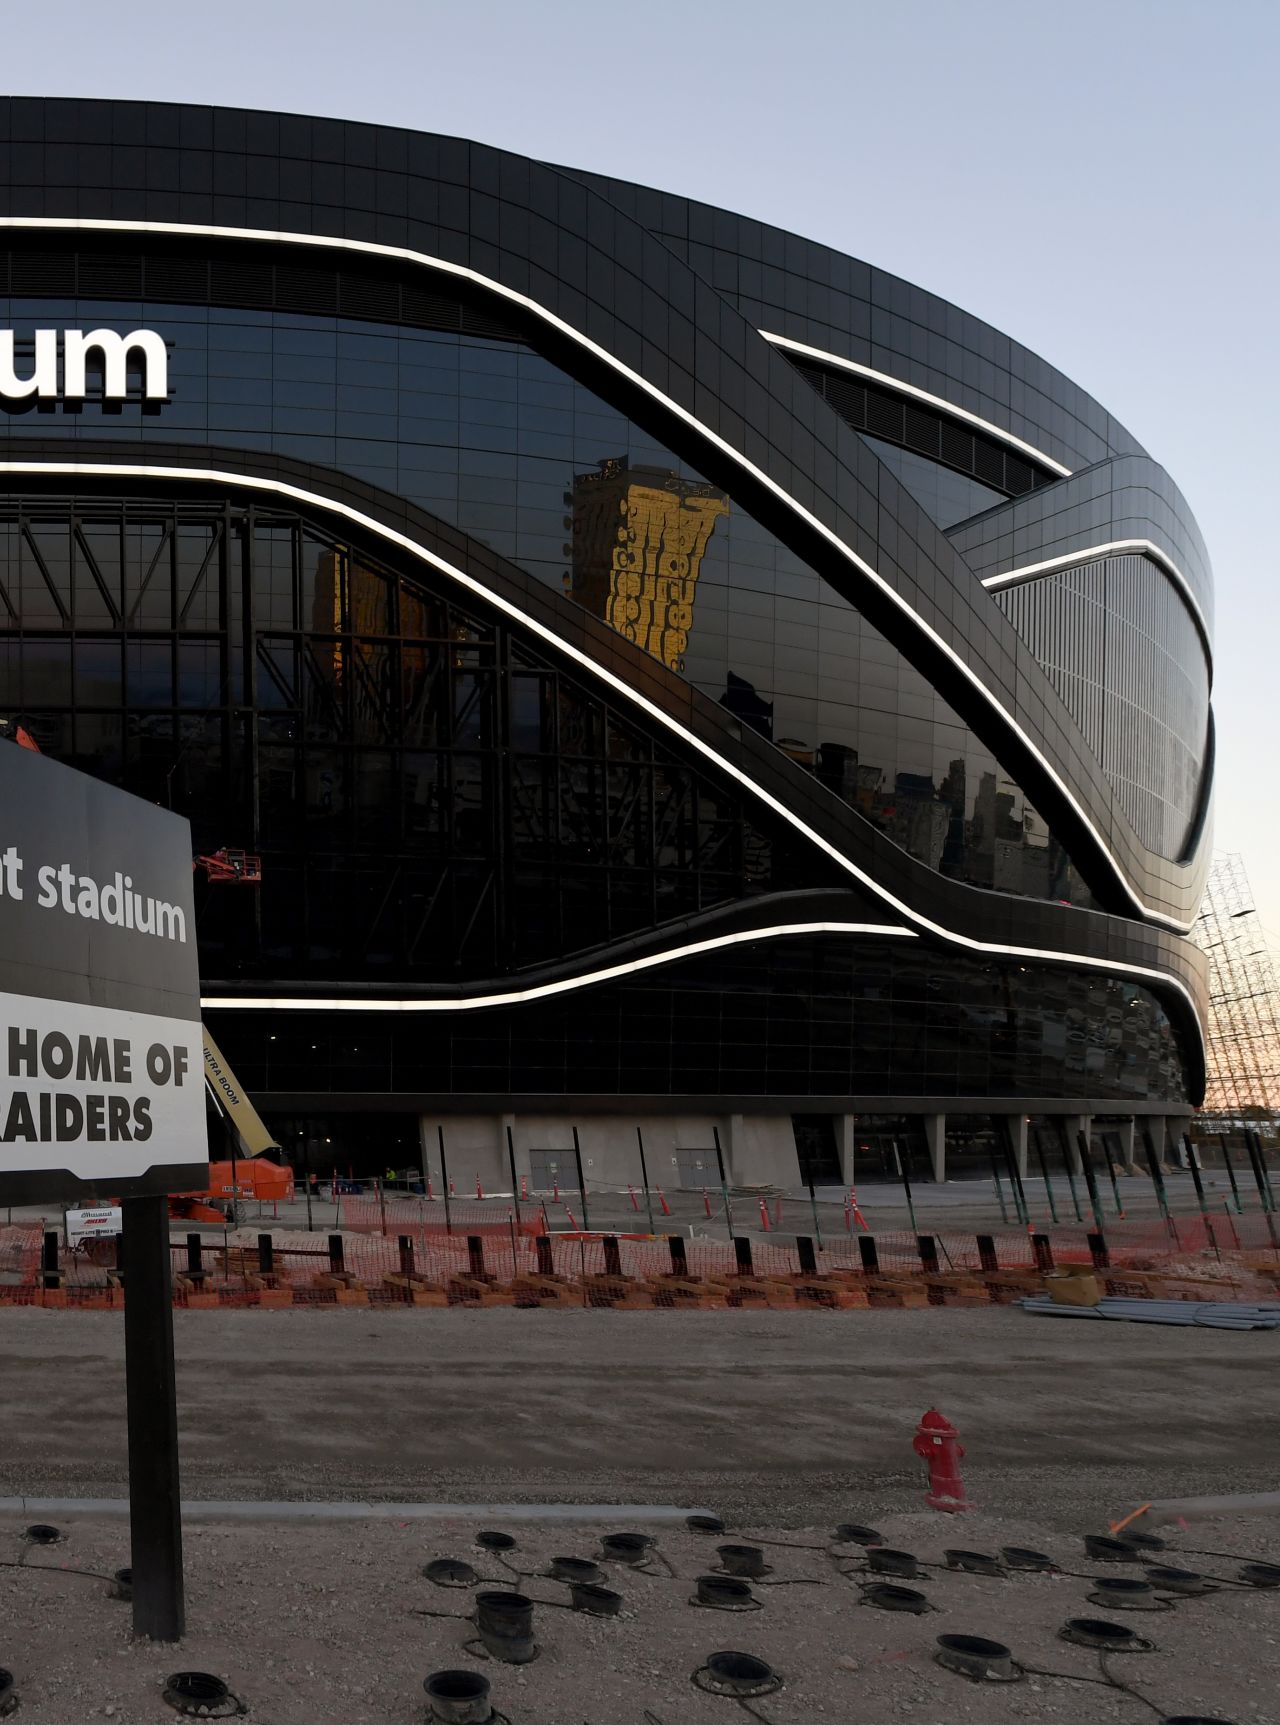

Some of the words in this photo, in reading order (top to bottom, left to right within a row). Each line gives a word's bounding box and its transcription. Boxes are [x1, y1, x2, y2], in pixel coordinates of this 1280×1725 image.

[38, 862, 186, 943] stadium
[8, 1027, 131, 1083] HOME
[147, 1043, 187, 1087] OF
[219, 1077, 240, 1105] BOOM
